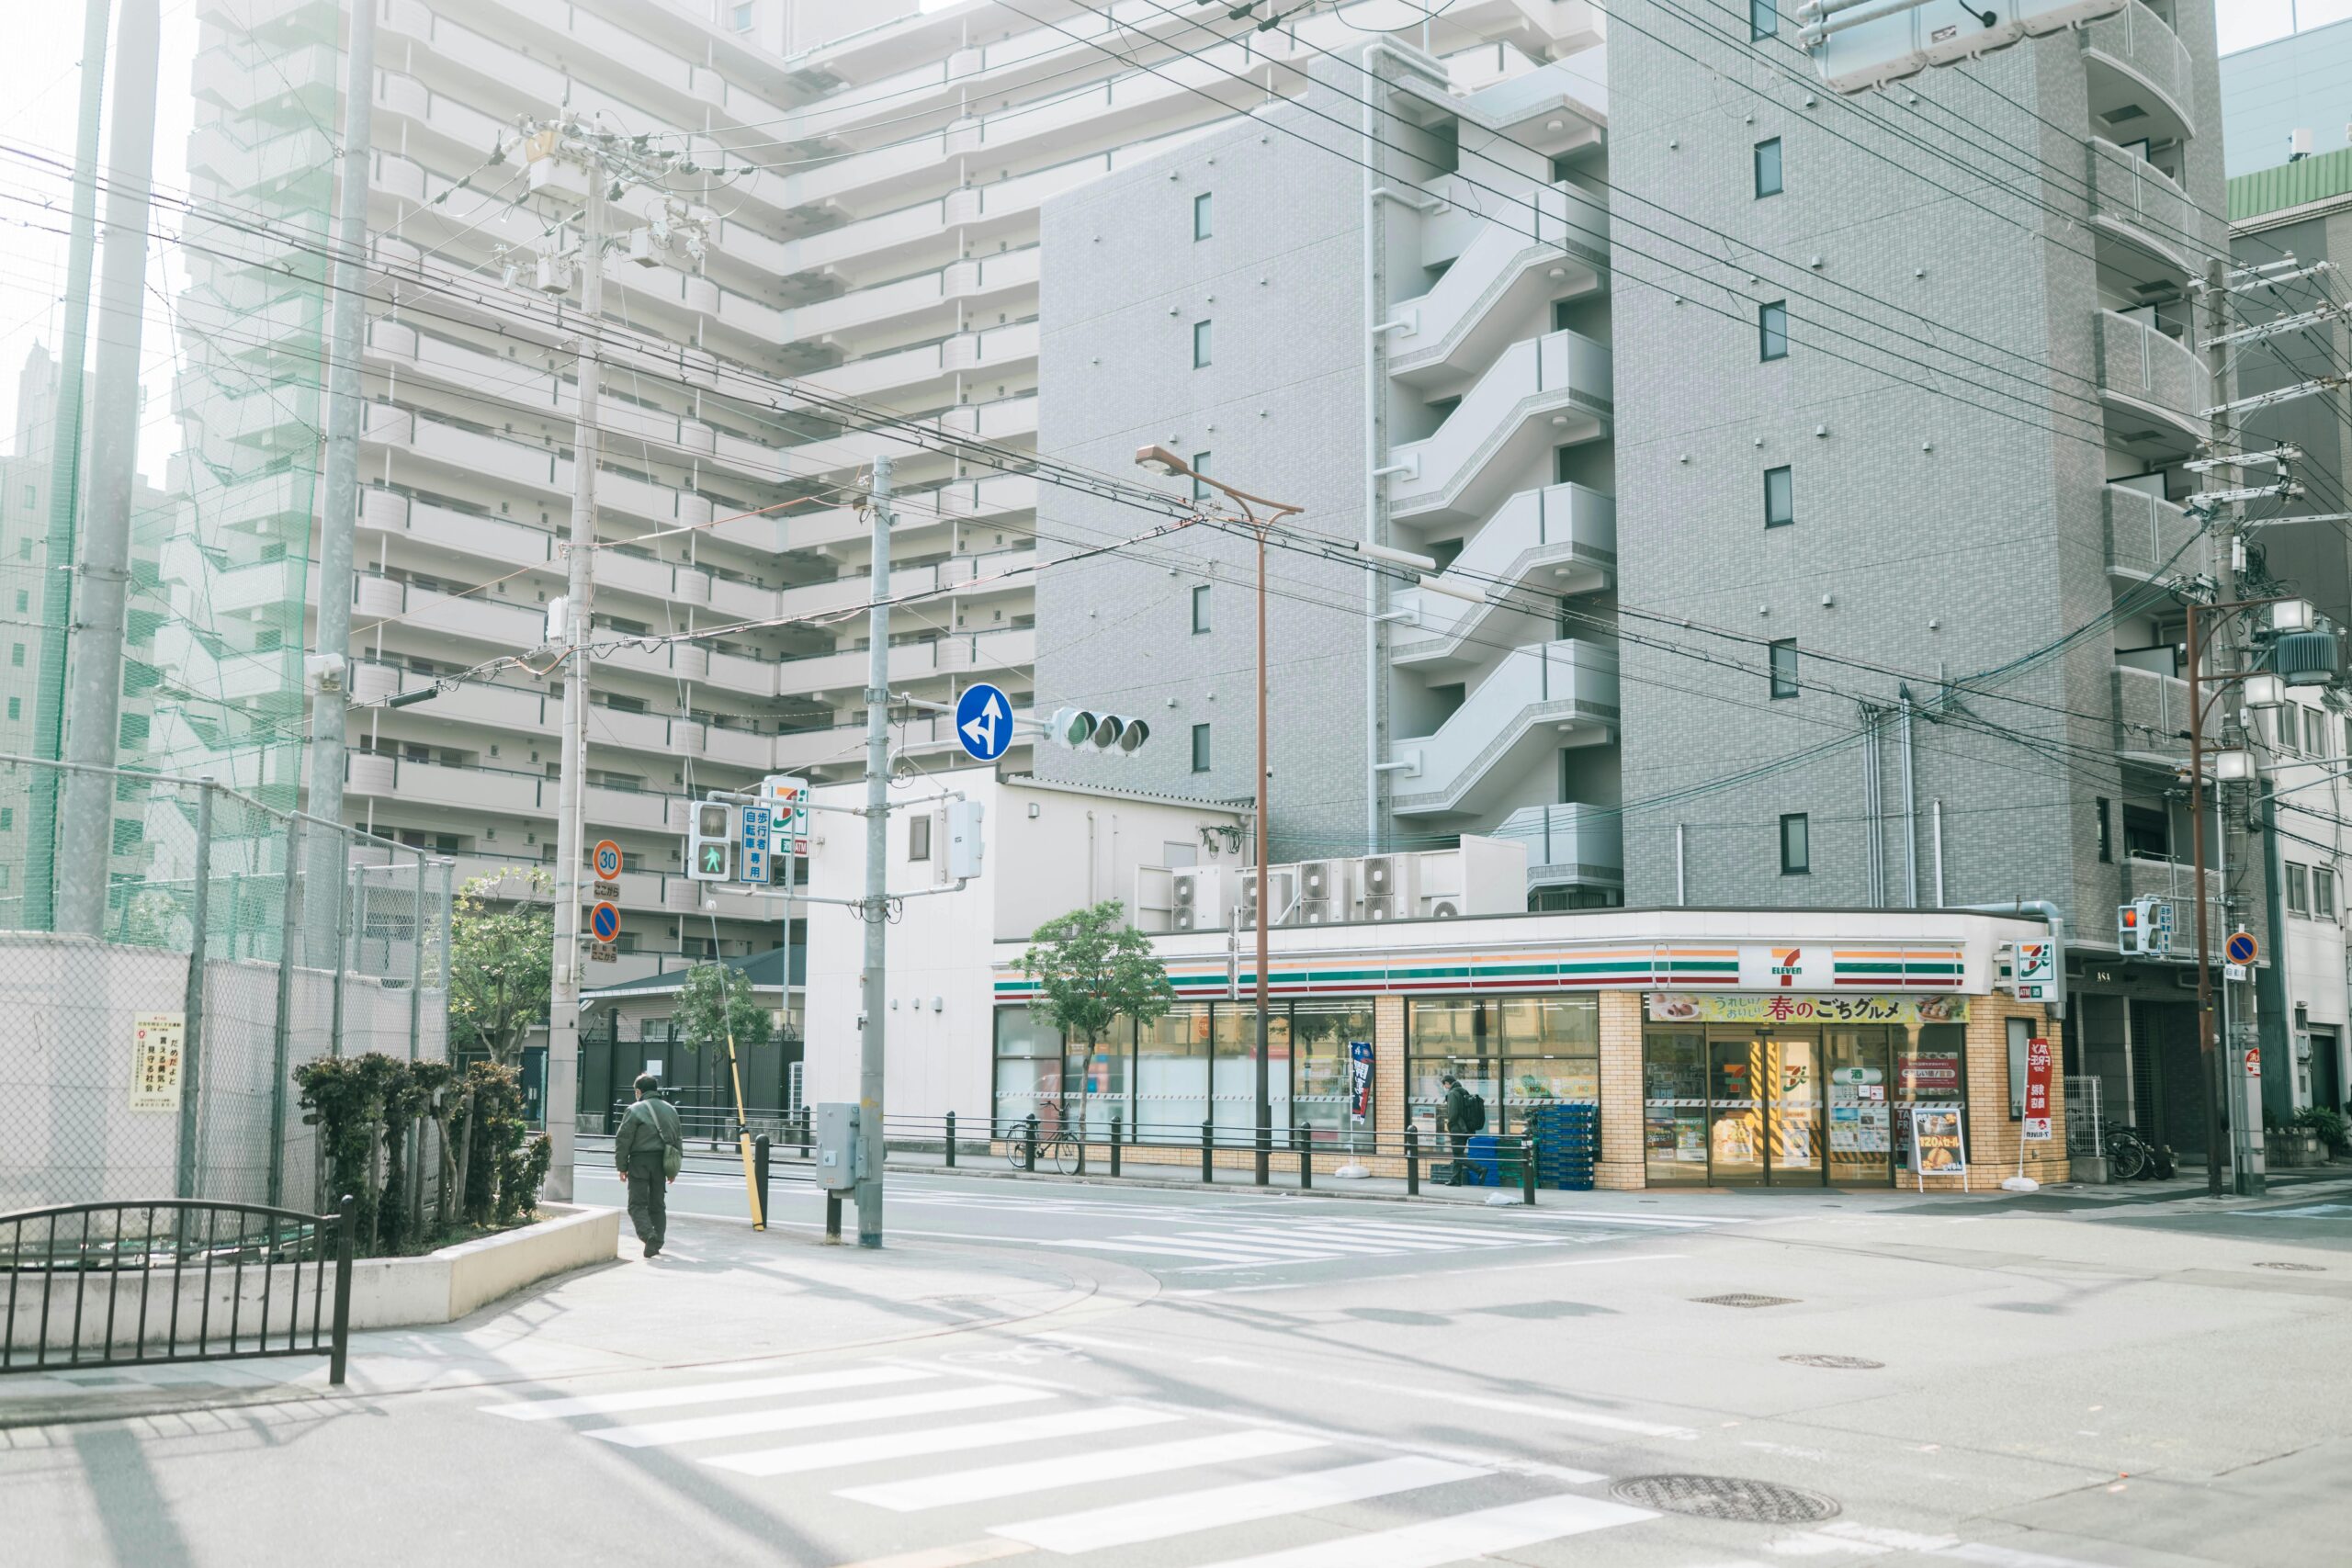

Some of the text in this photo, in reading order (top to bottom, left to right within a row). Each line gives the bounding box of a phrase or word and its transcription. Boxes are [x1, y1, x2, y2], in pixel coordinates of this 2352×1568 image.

[746, 812, 755, 848] 自転車
[757, 813, 767, 850] 歩行者
[795, 841, 807, 852] ATM
[600, 852, 616, 870] 30
[751, 852, 760, 878] 専用
[594, 885, 619, 897] ここから
[1763, 995, 1899, 1021] 春のごちグルメ
[145, 1045, 155, 1092] 見守る社会
[168, 1039, 178, 1086] だめだよと
[1851, 1069, 1863, 1079] 酒
[1897, 1110, 1910, 1120] TA
